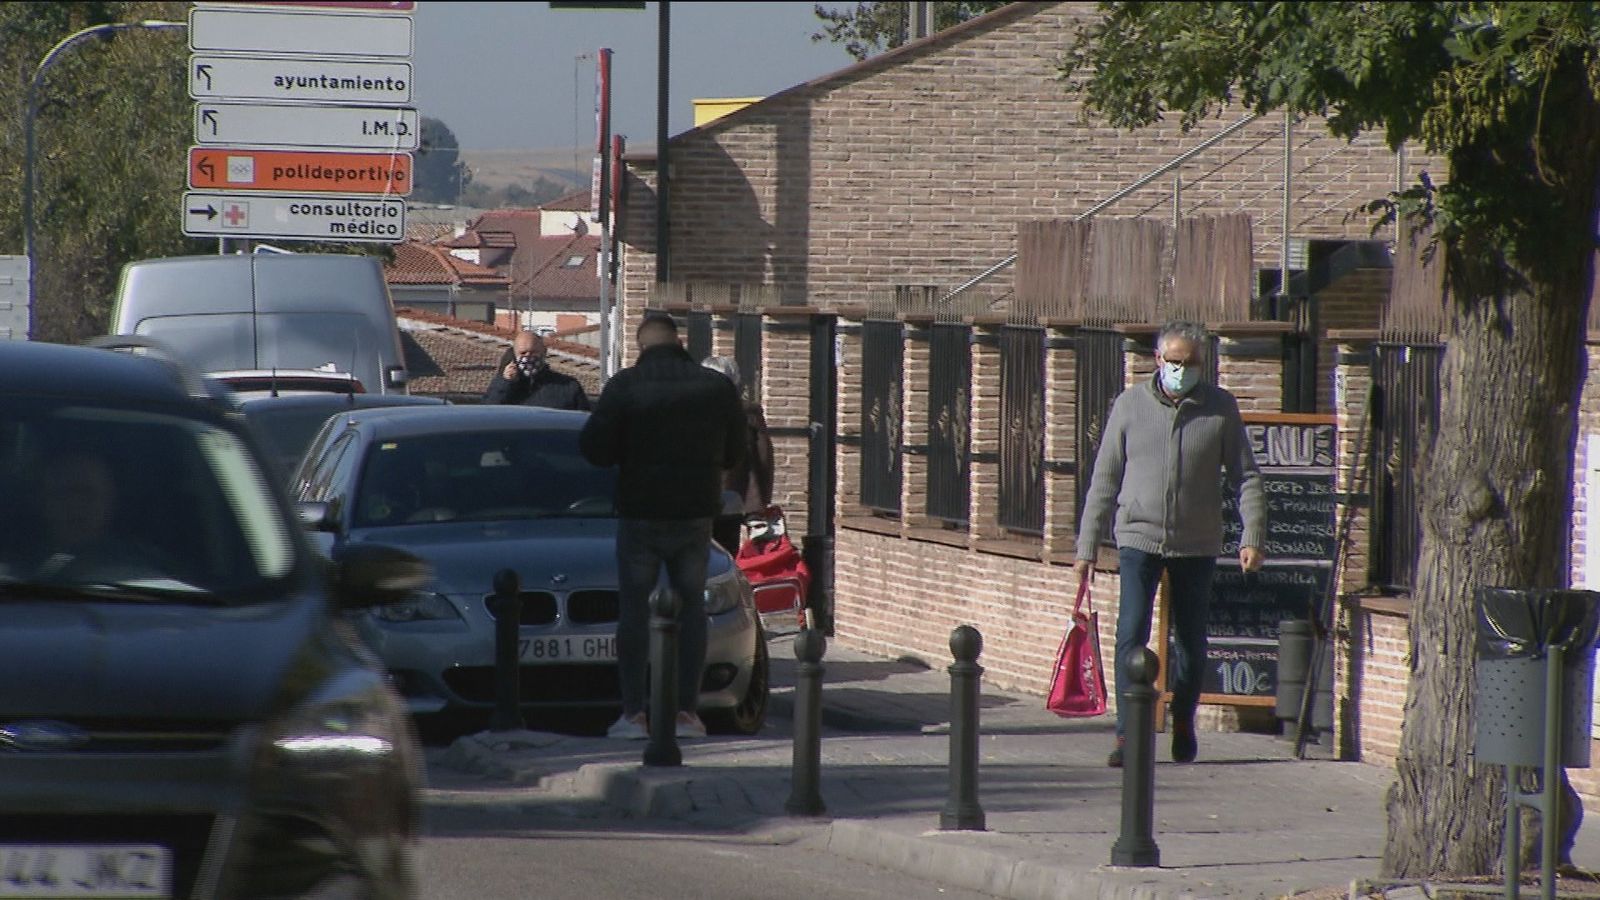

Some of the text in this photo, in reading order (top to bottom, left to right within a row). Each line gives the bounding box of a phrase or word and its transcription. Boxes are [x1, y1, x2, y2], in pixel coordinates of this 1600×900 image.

[274, 74, 405, 91] ayuntamiento
[272, 165, 405, 182] polideportivo
[290, 202, 398, 217] consultorio
[330, 218, 398, 234] médico
[1246, 425, 1314, 466] ENU
[519, 638, 572, 658] 7881
